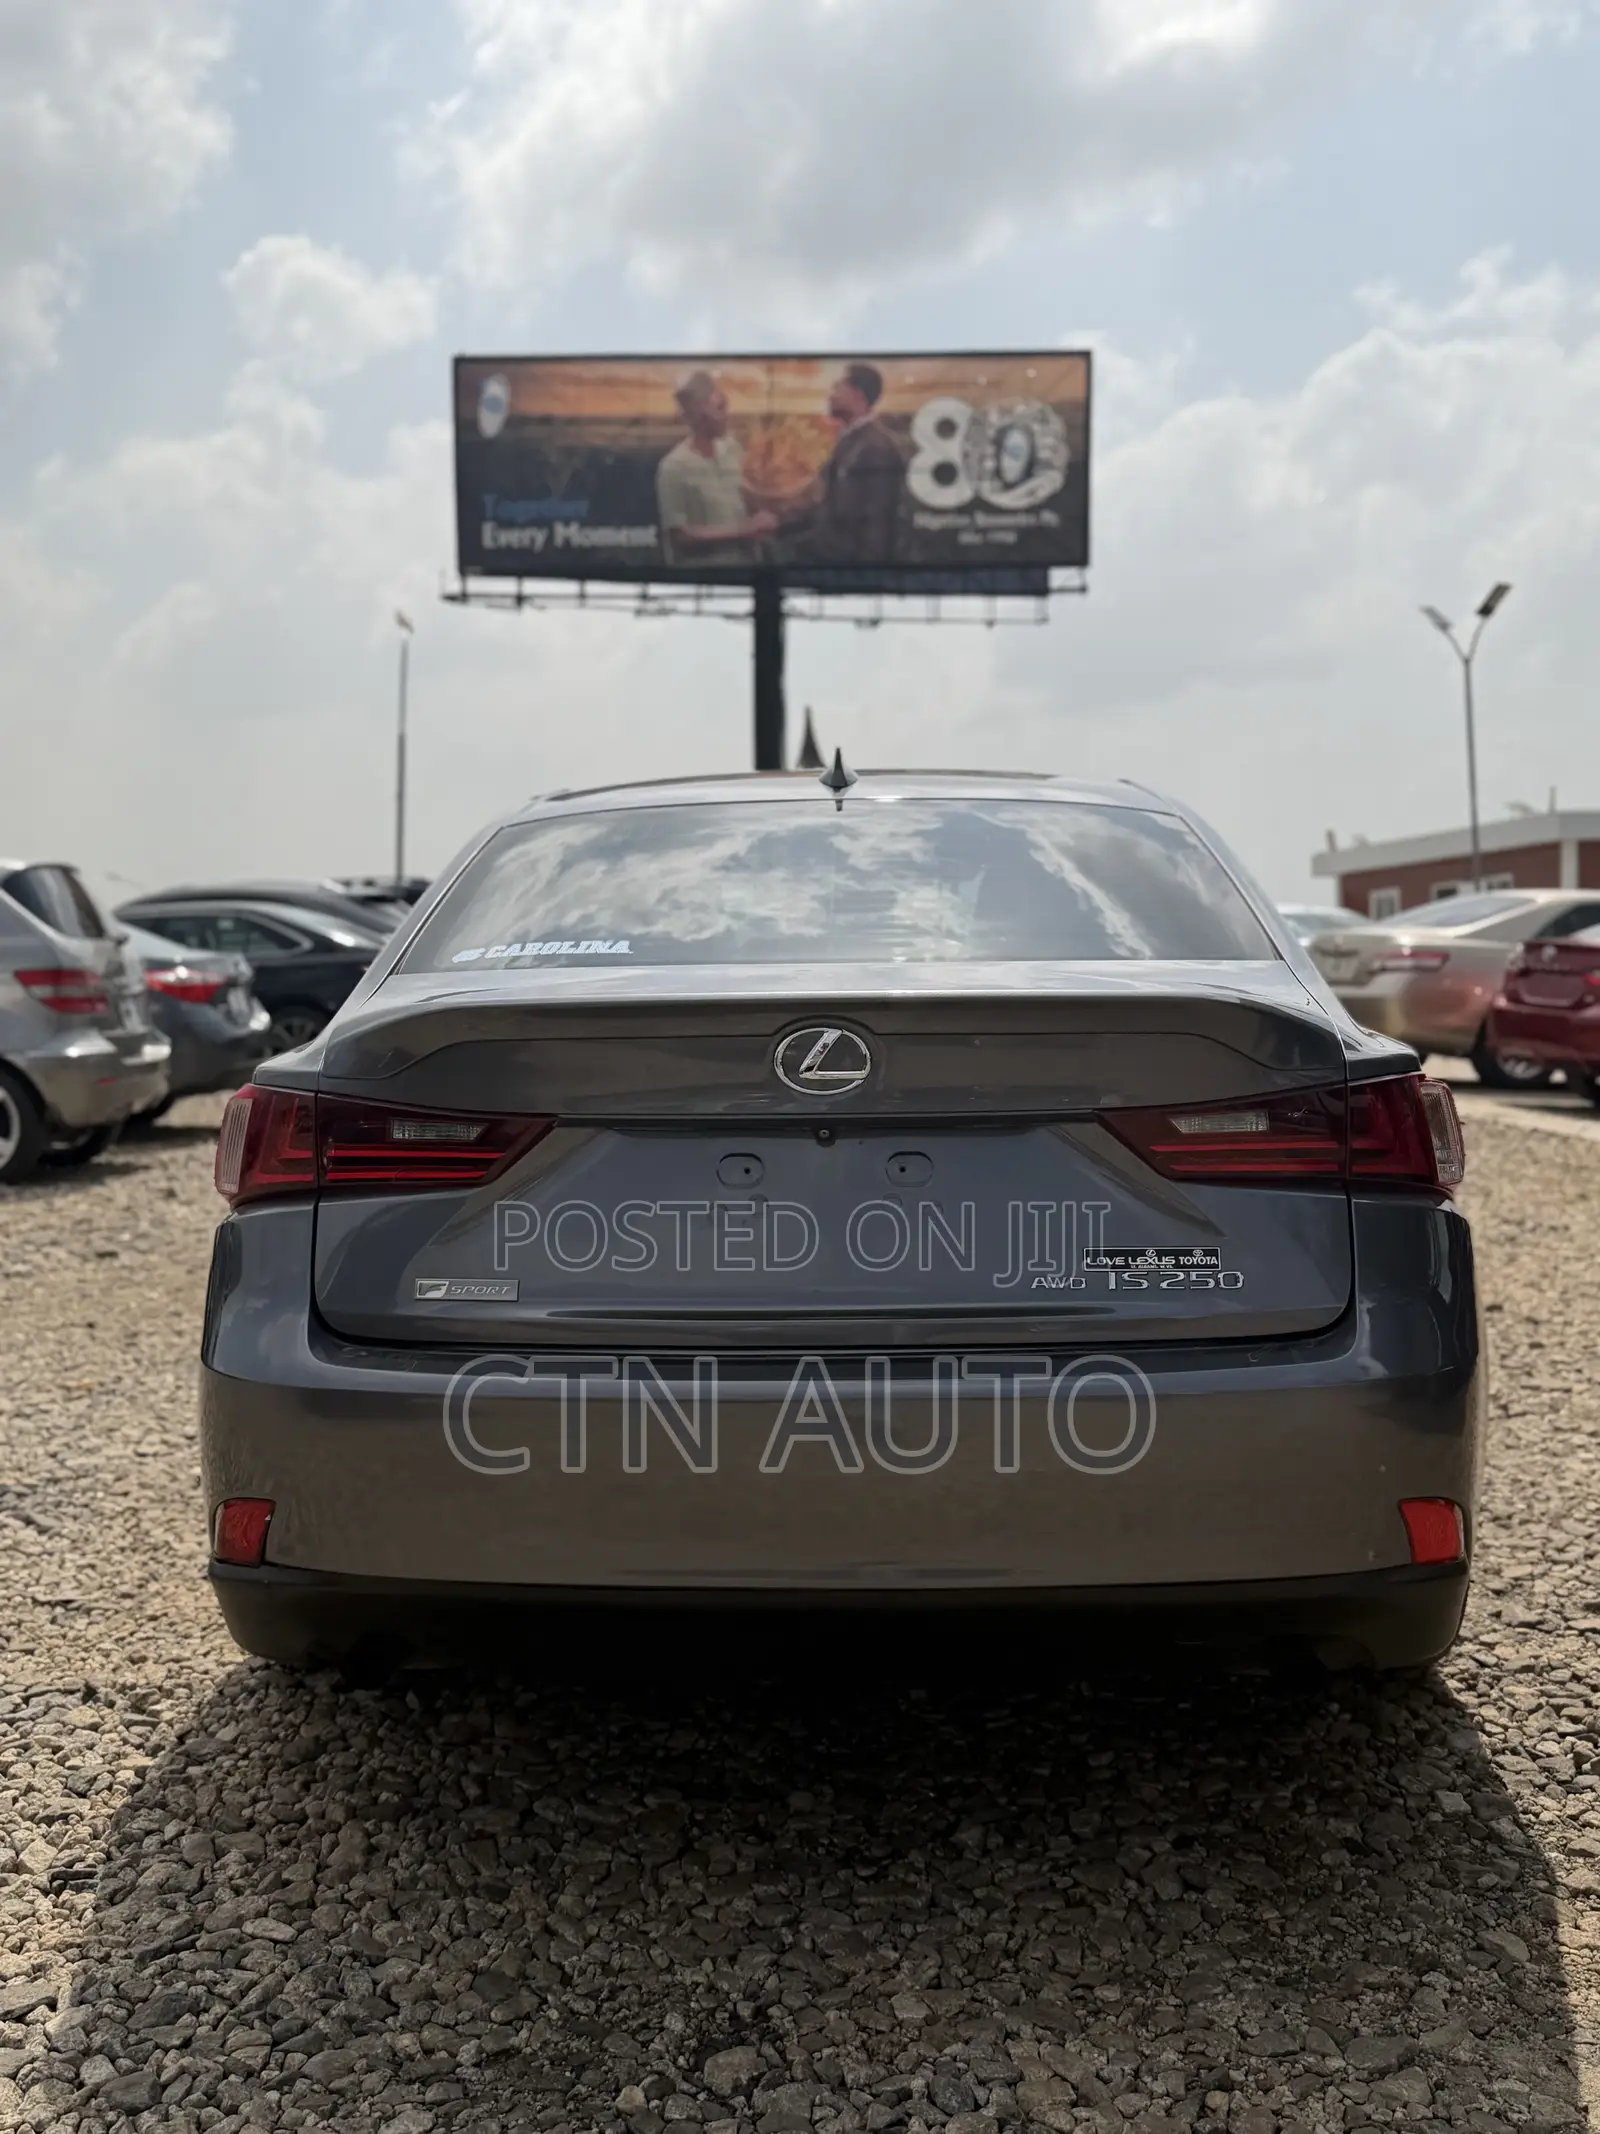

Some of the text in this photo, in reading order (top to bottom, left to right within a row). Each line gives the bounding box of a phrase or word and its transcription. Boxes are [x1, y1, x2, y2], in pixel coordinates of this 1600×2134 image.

[482, 520, 548, 554] Every
[485, 940, 632, 959] CAROLINA
[1087, 1255, 1219, 1265] LOVE LEXUS TOYOTA
[1031, 1271, 1244, 1290] AWD IS 250
[450, 1286, 510, 1295] SPORT
